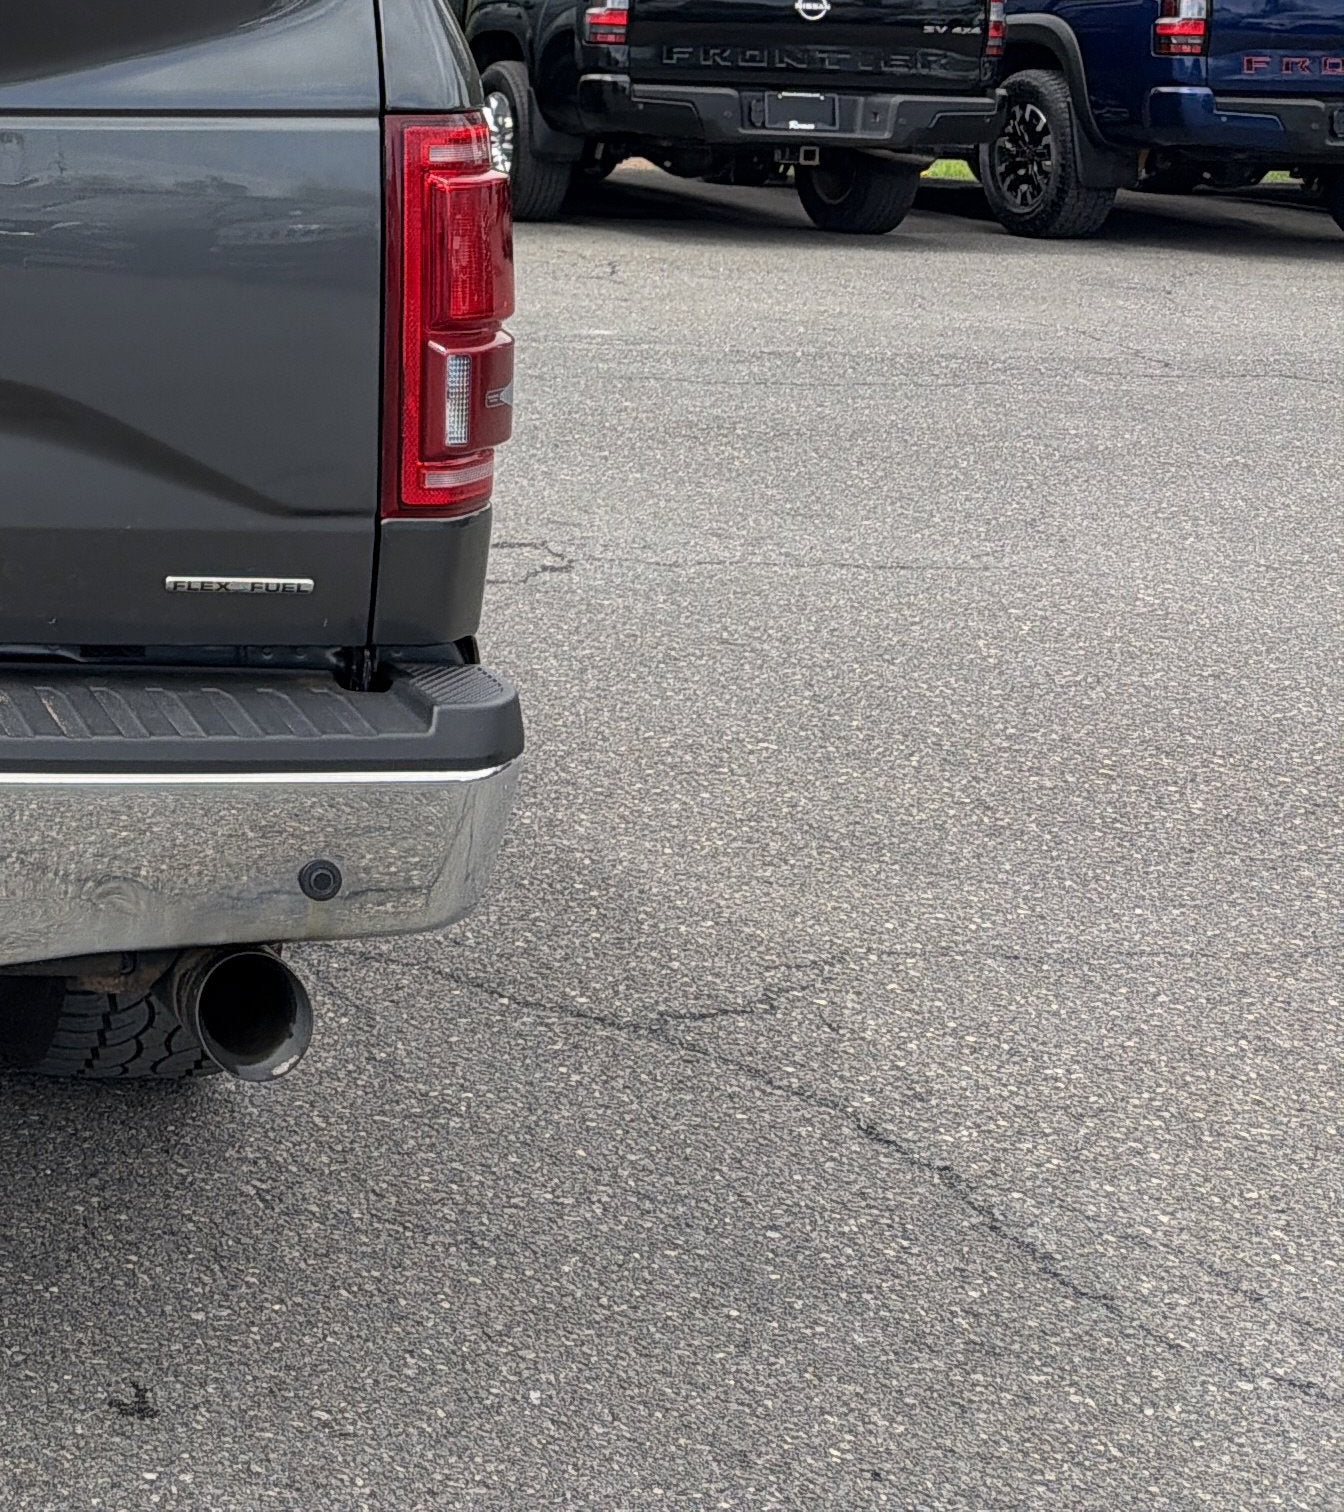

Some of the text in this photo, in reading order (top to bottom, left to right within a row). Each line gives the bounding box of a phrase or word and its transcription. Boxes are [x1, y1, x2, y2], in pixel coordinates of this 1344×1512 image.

[794, 2, 831, 11] NISSAN
[923, 25, 948, 34] SV
[663, 45, 952, 74] FRONTIER
[173, 580, 309, 593] FLEX FUEL
